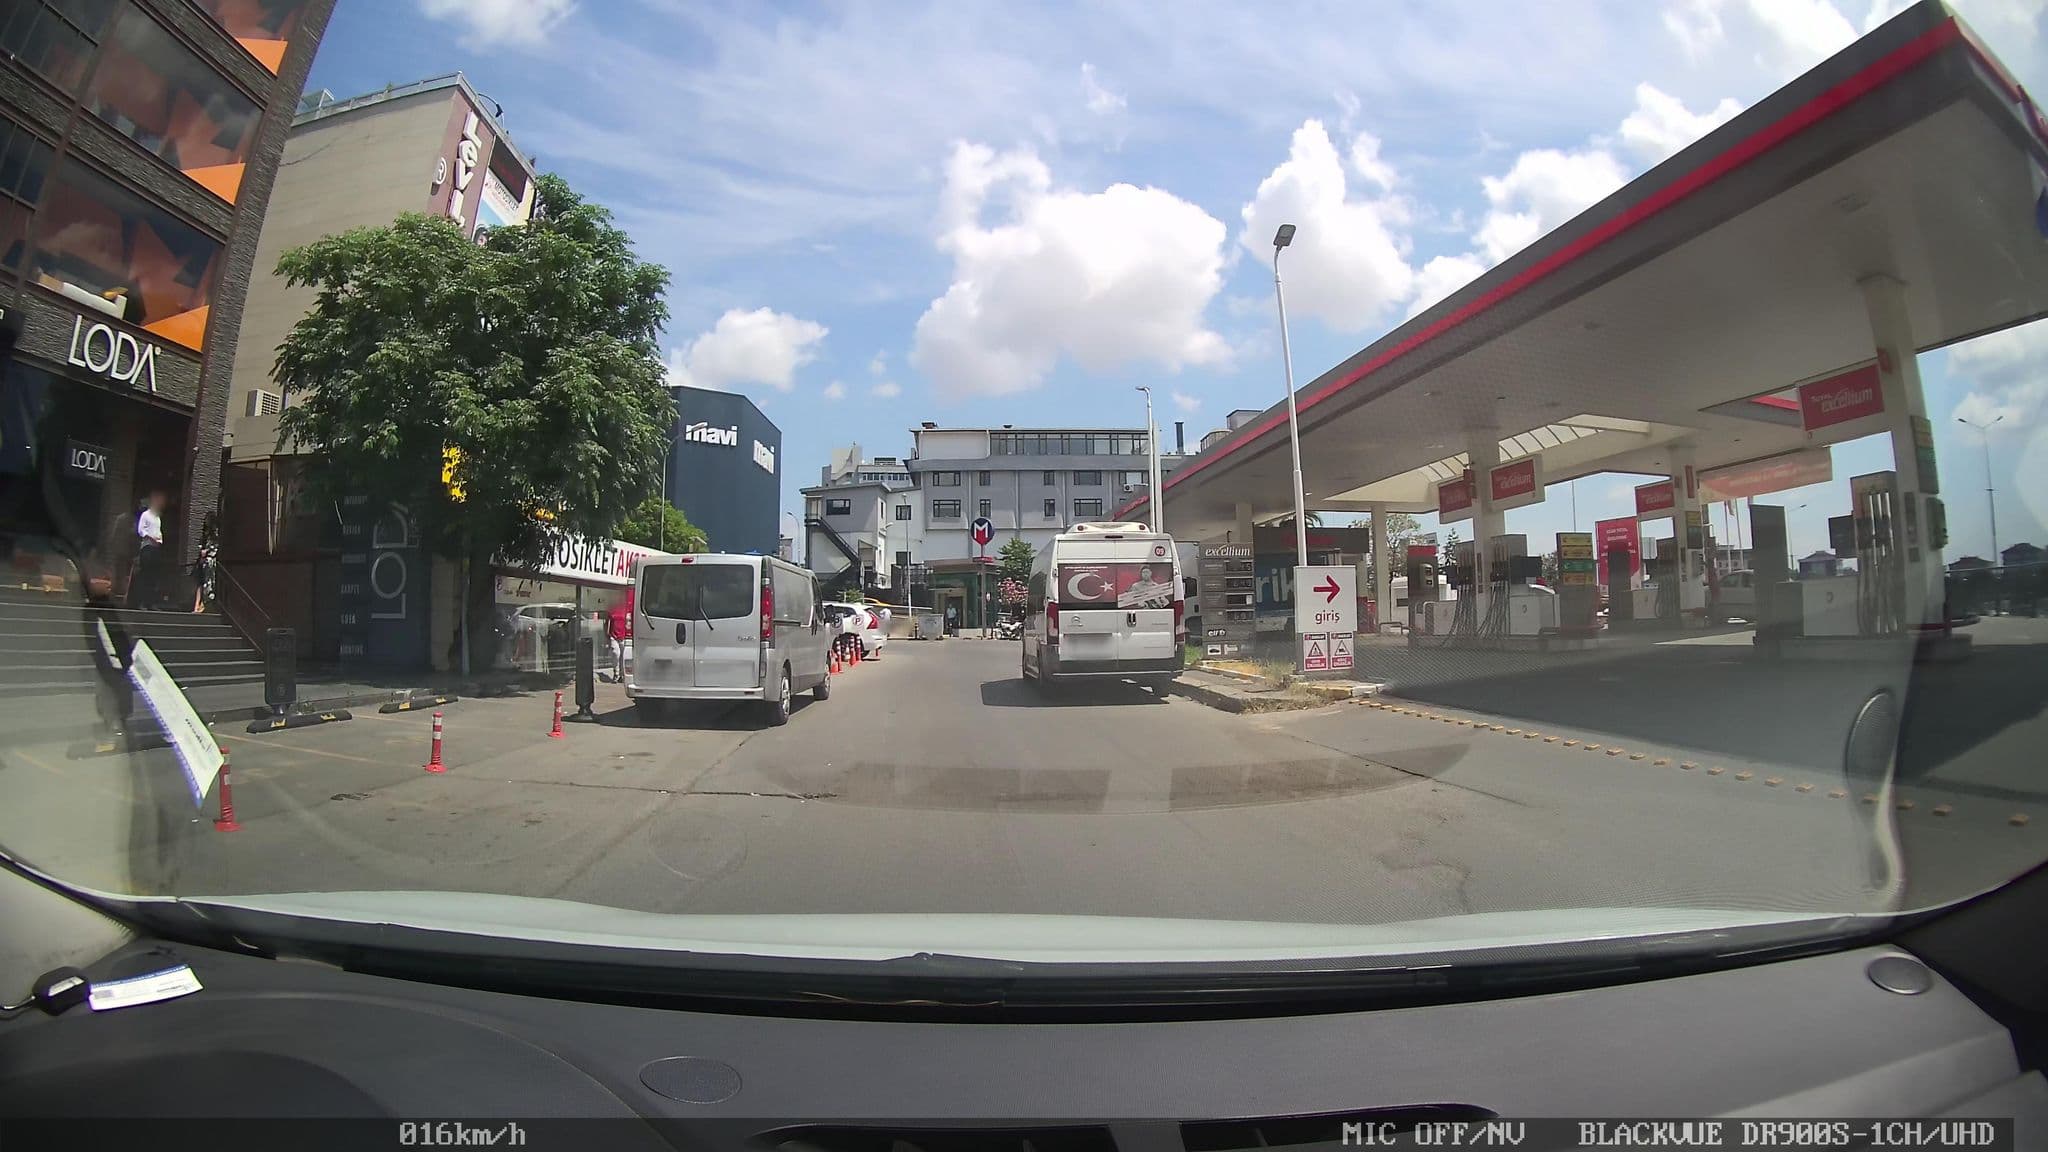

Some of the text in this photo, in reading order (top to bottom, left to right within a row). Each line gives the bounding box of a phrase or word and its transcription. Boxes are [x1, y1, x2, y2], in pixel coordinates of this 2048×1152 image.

[68, 315, 160, 392] LODA
[685, 422, 738, 446] mavi
[71, 449, 107, 473] LODA
[1205, 545, 1250, 557] excellium
[1315, 610, 1341, 624] giriş
